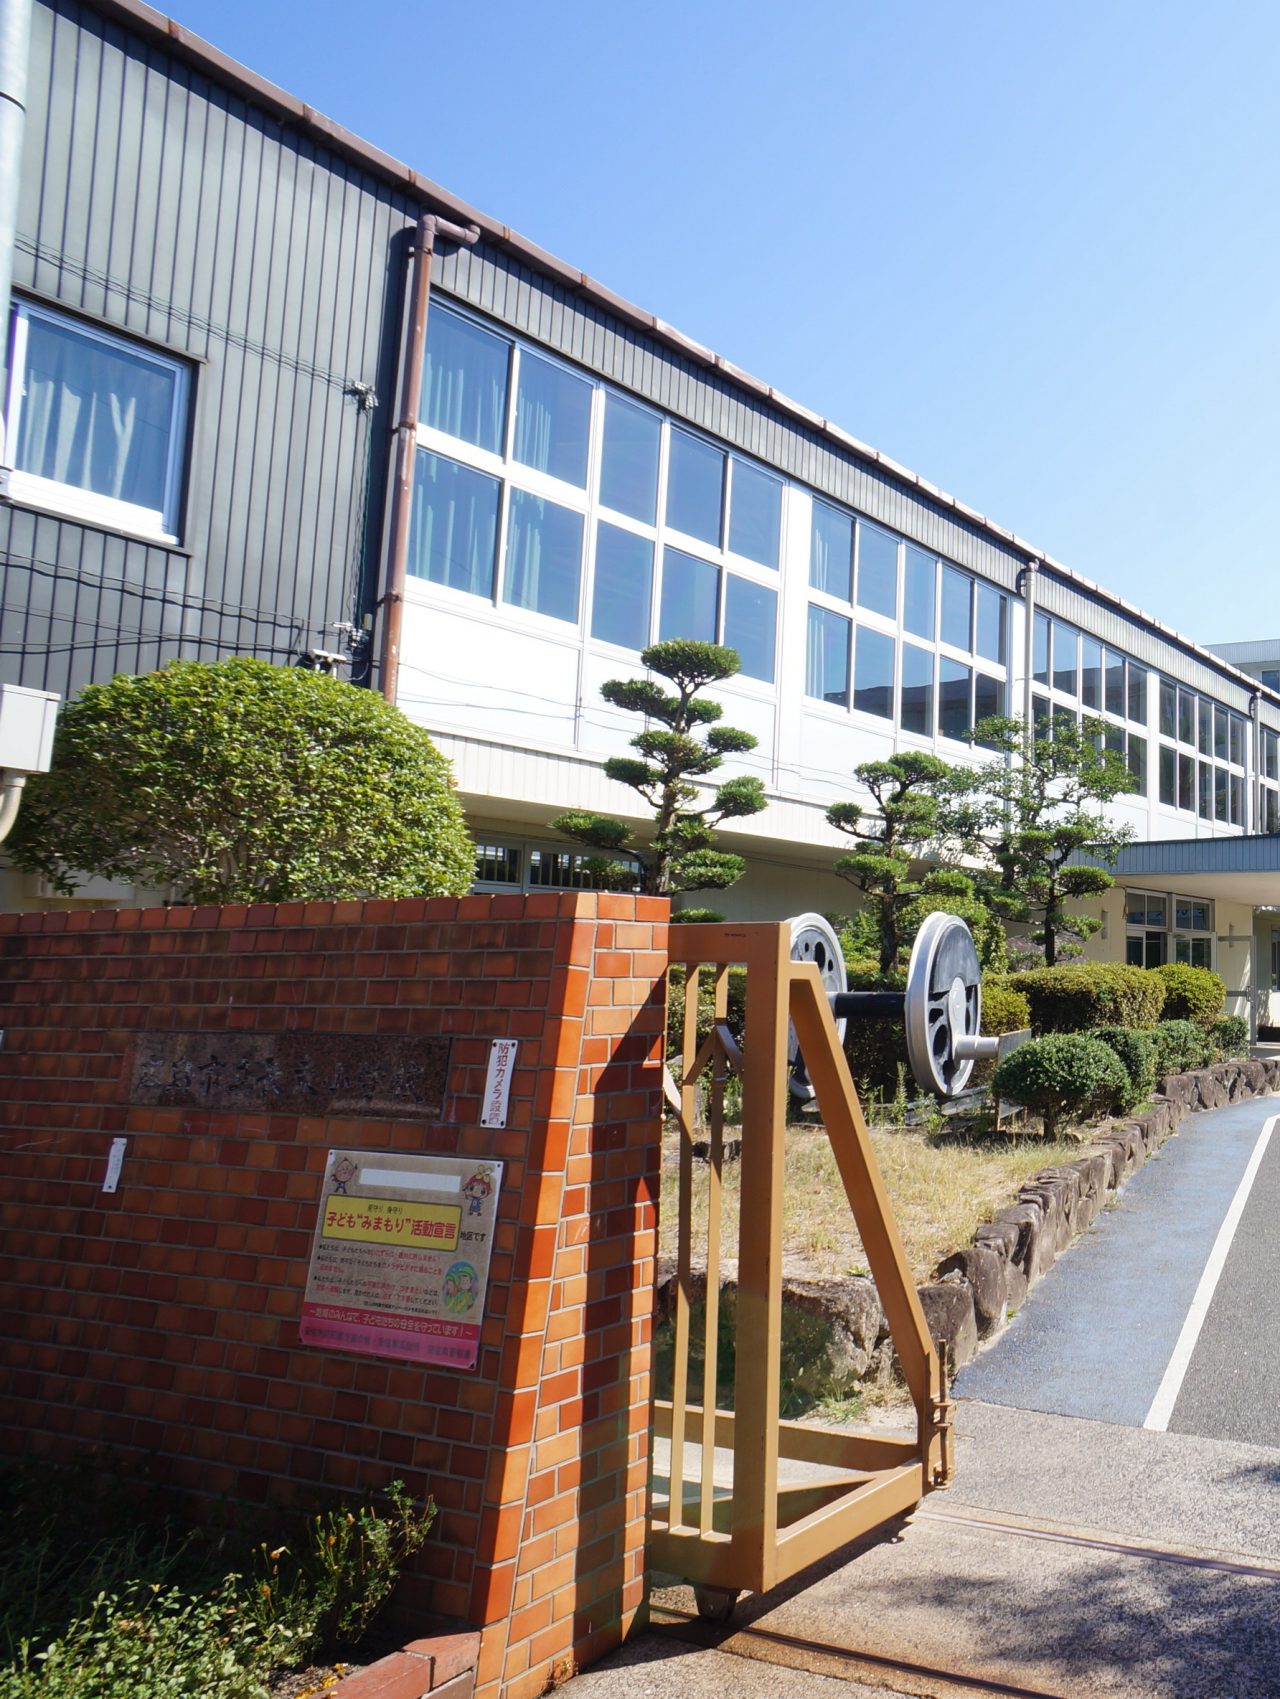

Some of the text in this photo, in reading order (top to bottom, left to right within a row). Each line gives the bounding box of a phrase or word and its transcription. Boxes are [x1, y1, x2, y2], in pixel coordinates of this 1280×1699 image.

[487, 1042, 511, 1125] 防犯カメラ設置
